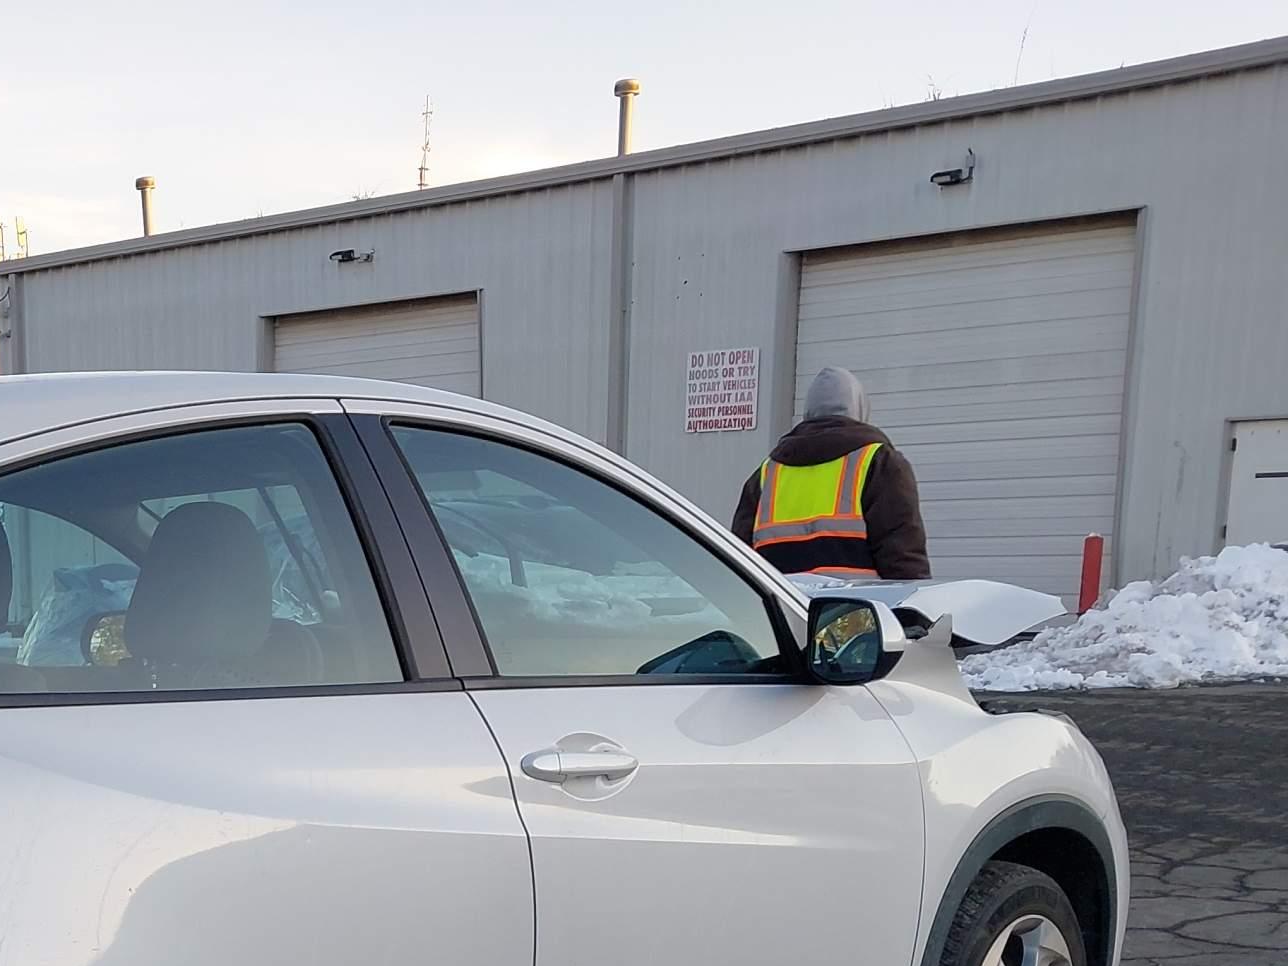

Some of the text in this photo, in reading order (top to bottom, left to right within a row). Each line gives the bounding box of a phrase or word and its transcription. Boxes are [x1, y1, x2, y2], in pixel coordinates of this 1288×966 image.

[691, 350, 754, 368] DO NOT OPEN
[688, 366, 755, 380] HOODS OR TRY
[688, 379, 756, 393] TO START VEHICLES
[688, 391, 753, 405] WITHOUT IAA
[687, 405, 753, 418] SECURITY PERSONNEL
[687, 418, 753, 431] AUTHORIZATION
